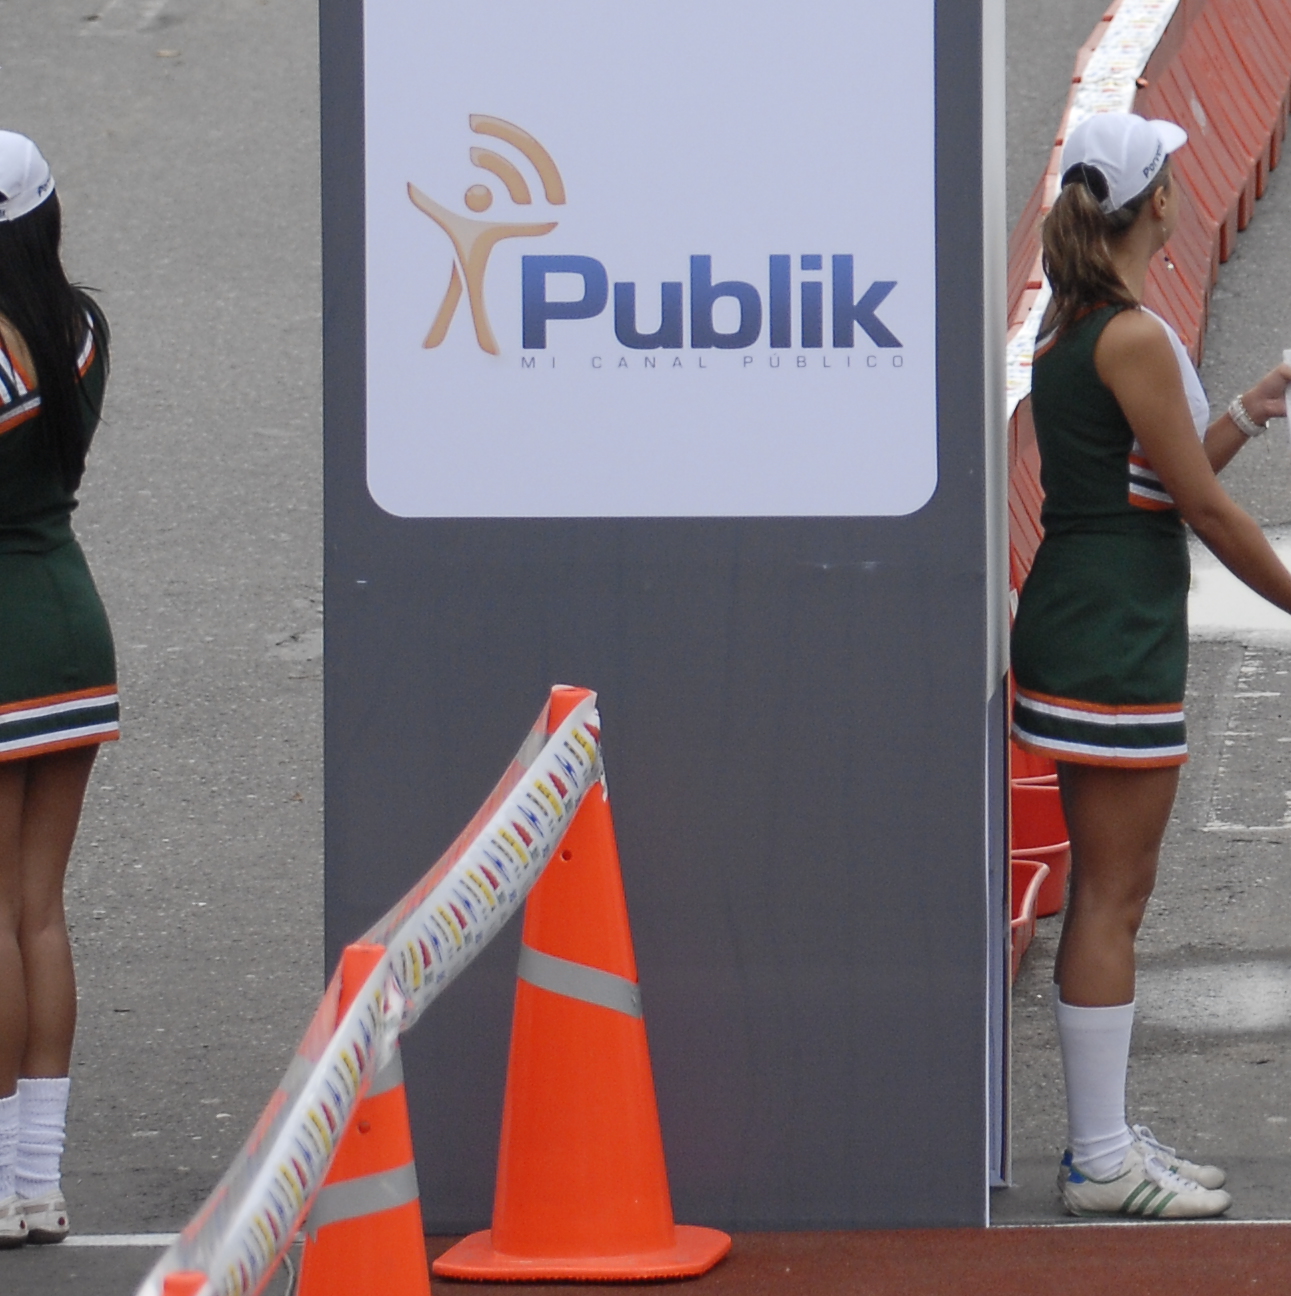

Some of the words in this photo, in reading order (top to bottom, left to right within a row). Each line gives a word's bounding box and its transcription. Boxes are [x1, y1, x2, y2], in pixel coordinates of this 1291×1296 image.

[521, 254, 904, 350] Publik
[518, 354, 560, 370] MI
[590, 354, 710, 370] CANAL
[740, 350, 906, 370] PÚBLICO
